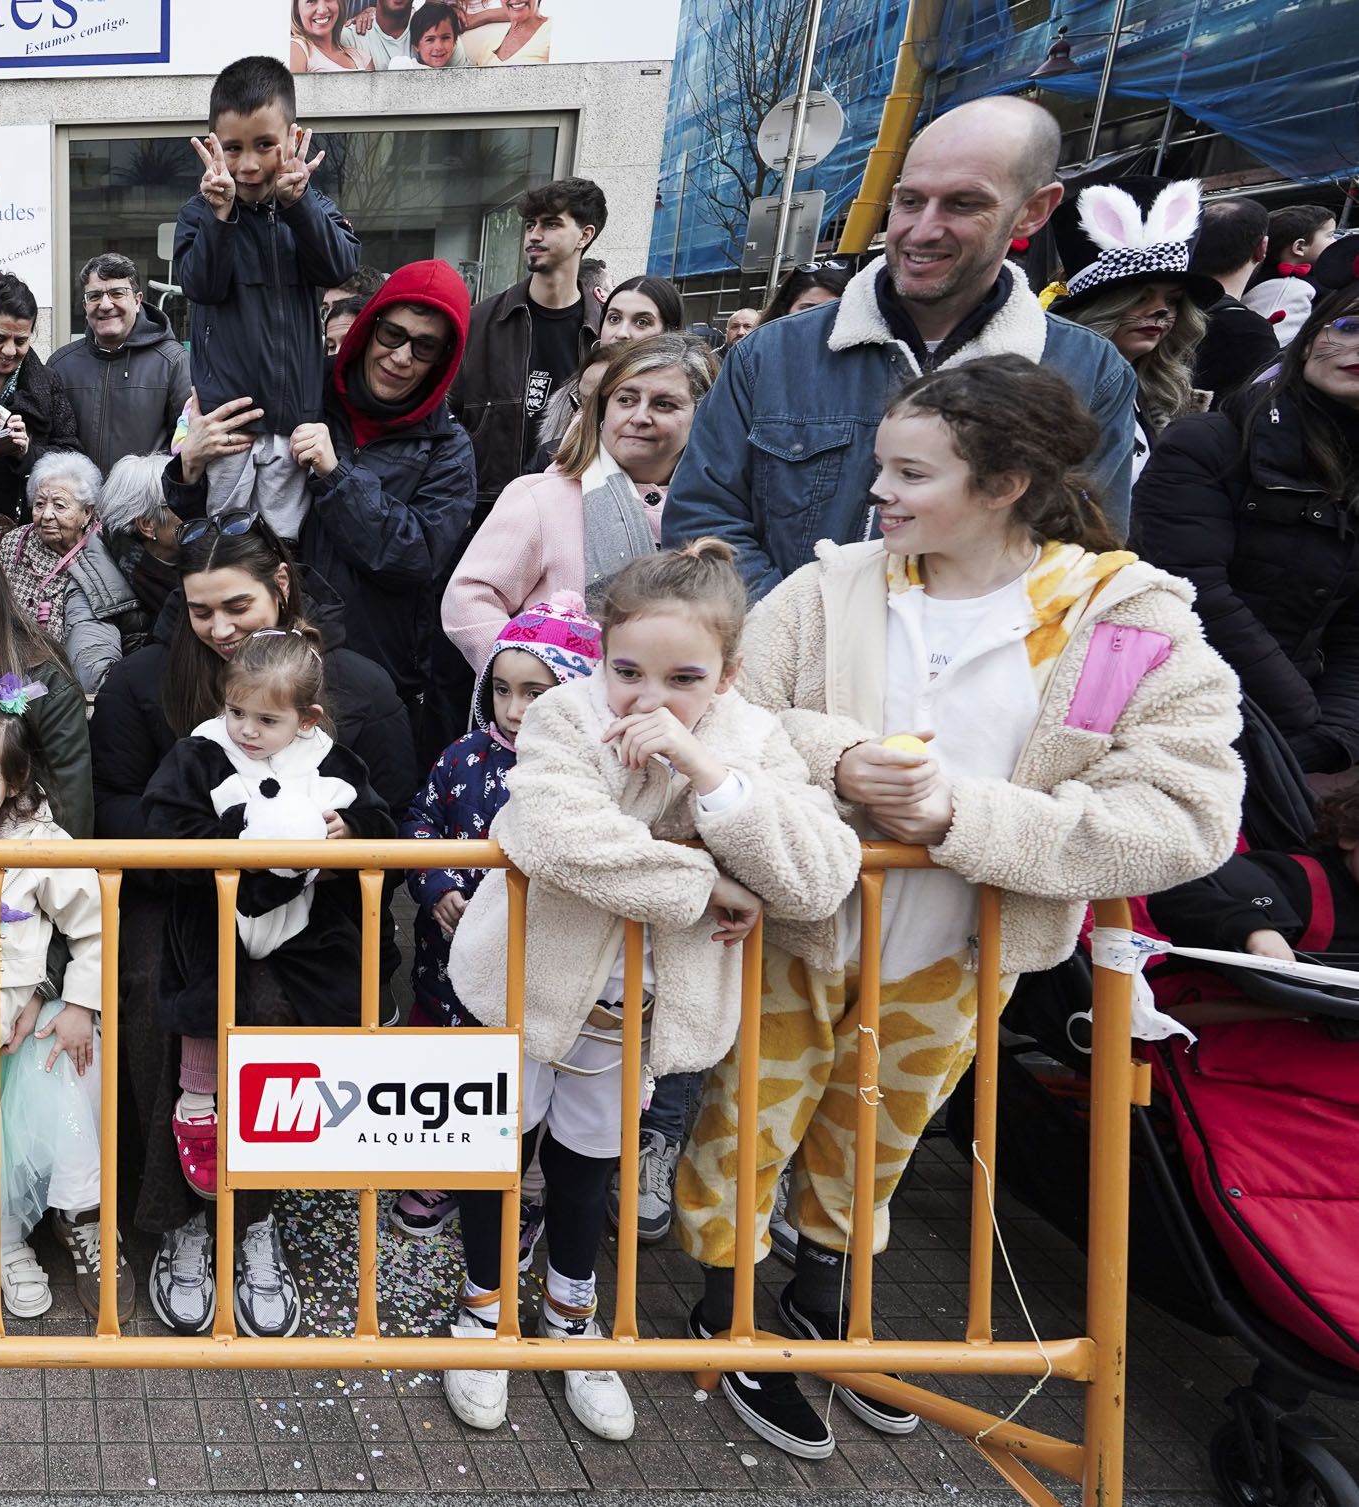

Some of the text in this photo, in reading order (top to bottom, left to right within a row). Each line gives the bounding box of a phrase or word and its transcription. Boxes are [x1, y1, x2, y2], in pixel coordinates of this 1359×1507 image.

[25, 17, 129, 55] Estamos contigo.
[253, 1072, 508, 1132] Myagal
[357, 1132, 472, 1146] ALQUILER
